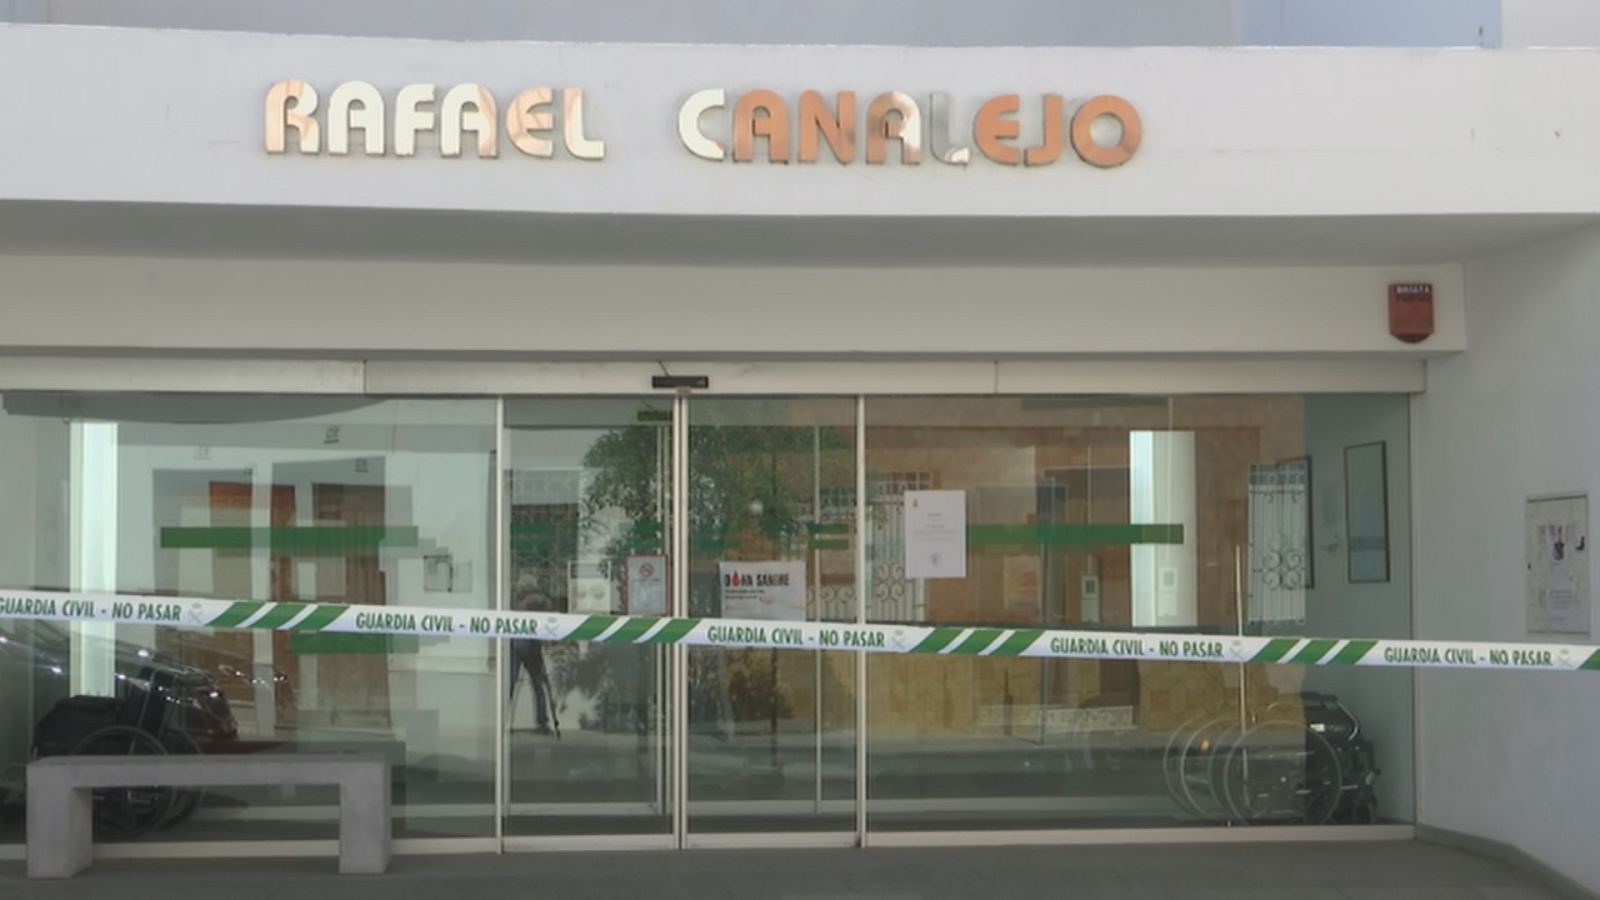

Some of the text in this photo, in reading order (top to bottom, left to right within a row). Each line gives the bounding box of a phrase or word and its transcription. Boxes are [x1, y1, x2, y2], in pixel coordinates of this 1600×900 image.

[265, 79, 1143, 168] RAFAEL CANALEJO
[62, 600, 96, 618] CIVIL
[111, 602, 133, 619] NO
[137, 603, 182, 621] PASAR
[355, 612, 416, 631] GUARDIA
[421, 615, 454, 633] CIVIL
[470, 617, 491, 634] NO
[495, 618, 538, 635] PASAR
[707, 625, 767, 644] GUARDIA
[771, 628, 804, 645] CIVIL
[819, 630, 839, 646] NO
[843, 631, 886, 648] PASAR
[1050, 637, 1109, 655] GUARDIA
[1112, 639, 1145, 656] CIVIL
[1159, 641, 1179, 657] NO
[1183, 642, 1225, 658] PASAR
[1384, 647, 1441, 664] GUARDIA
[1444, 649, 1476, 665] CIVIL
[1489, 650, 1509, 665] NO
[1513, 651, 1553, 666] PASAR
